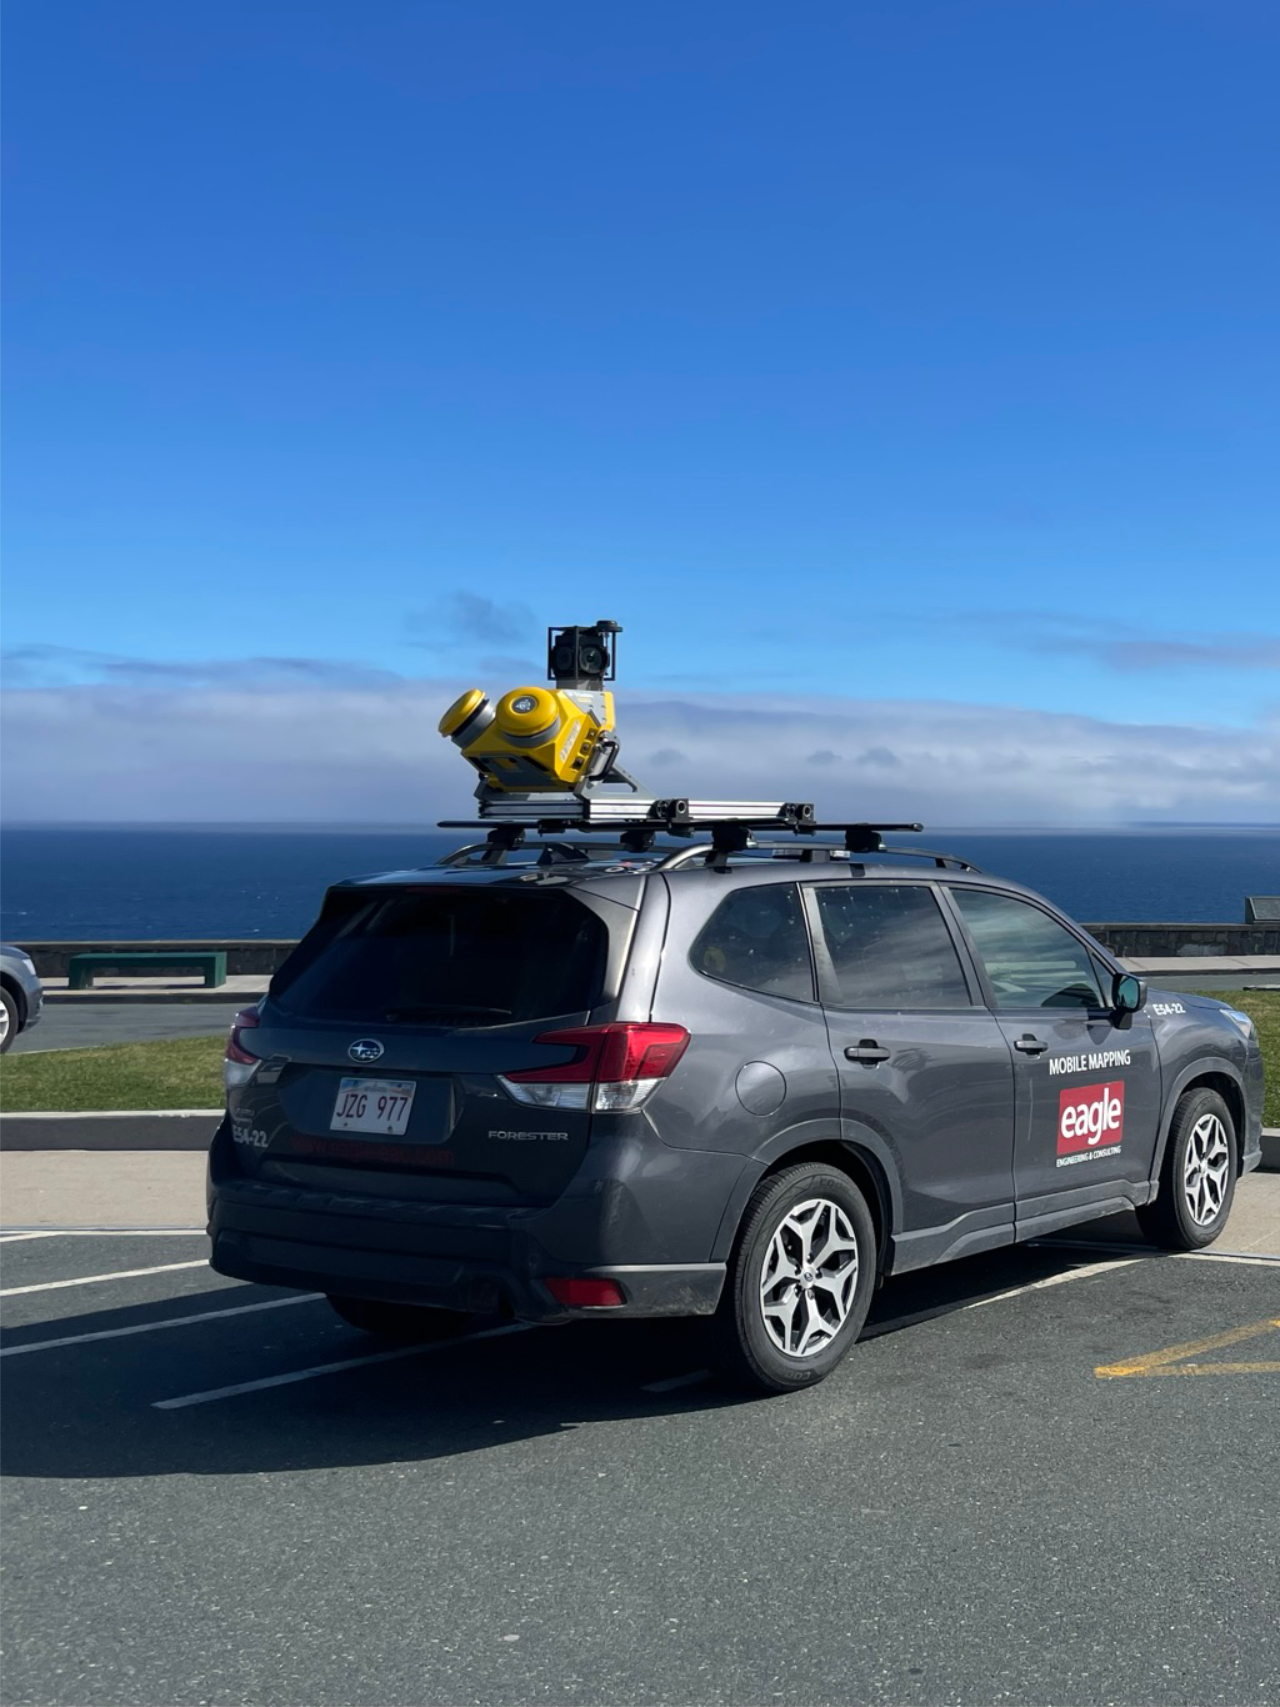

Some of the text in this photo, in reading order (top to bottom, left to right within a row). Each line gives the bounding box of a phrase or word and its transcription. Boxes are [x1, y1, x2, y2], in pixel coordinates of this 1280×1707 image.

[1152, 1002, 1186, 1016] E54-22
[1049, 1049, 1131, 1076] MOBILE MAPPING
[336, 1093, 409, 1122] JZG 977
[1061, 1087, 1121, 1145] eagle
[233, 1124, 269, 1148] E54-22
[488, 1130, 569, 1141] FORESTER
[1056, 1152, 1089, 1168] ENGINEERING
[1093, 1145, 1122, 1159] CONSULTING
